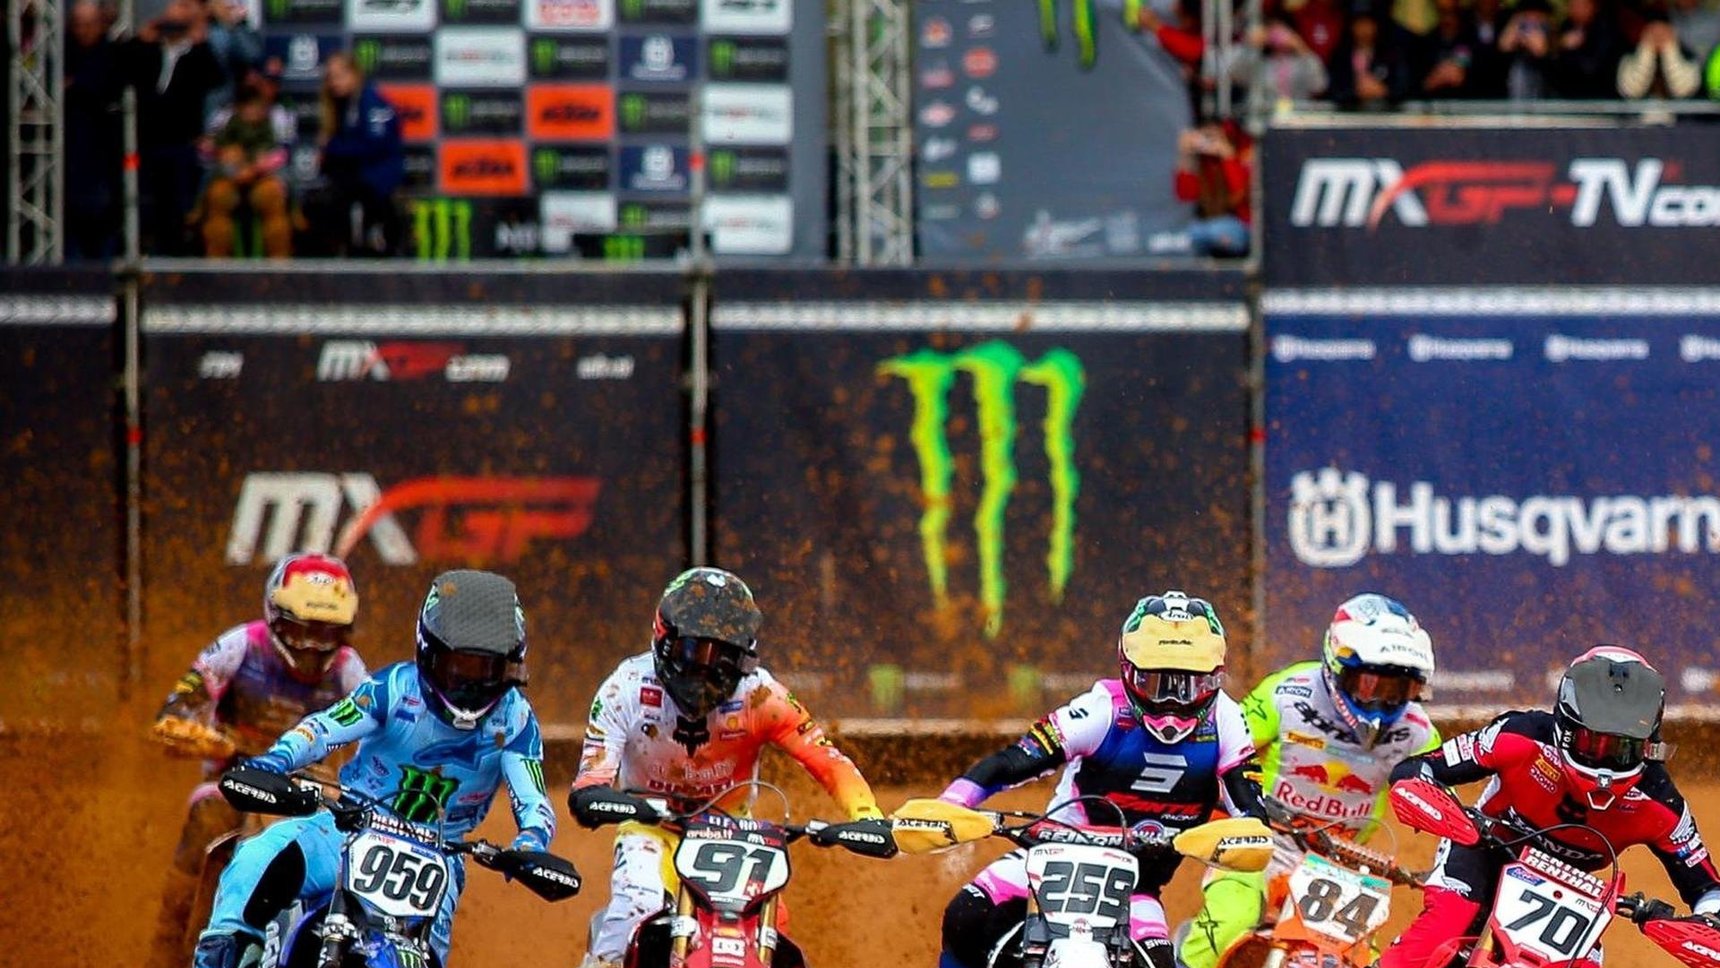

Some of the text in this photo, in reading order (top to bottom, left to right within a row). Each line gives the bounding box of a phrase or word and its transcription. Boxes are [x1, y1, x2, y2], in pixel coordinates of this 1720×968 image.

[226, 472, 600, 566] MXGP
[1562, 729, 1574, 749] FOX
[223, 779, 277, 804] ACERBIS
[1277, 782, 1372, 819] Red Bull
[1220, 836, 1268, 846] ACERBIS
[354, 845, 446, 911] 959
[533, 866, 580, 889] ACERBIS
[693, 843, 777, 897] 91
[1038, 860, 1136, 921] 259
[1524, 855, 1603, 898] RENTHAL
[1300, 878, 1382, 937] 84
[1504, 888, 1590, 955] 70
